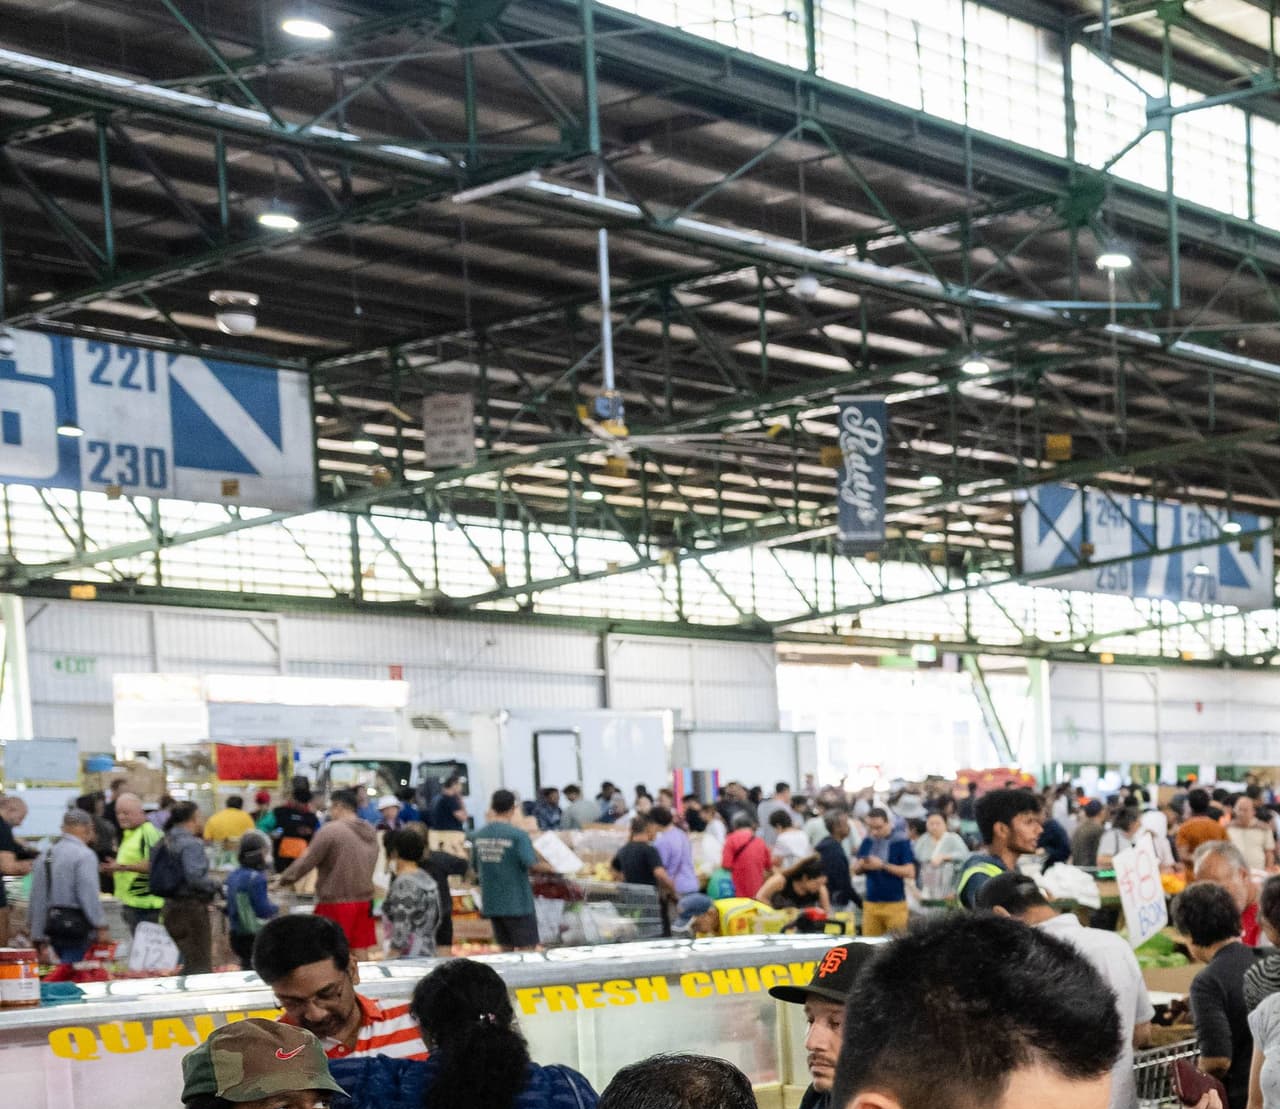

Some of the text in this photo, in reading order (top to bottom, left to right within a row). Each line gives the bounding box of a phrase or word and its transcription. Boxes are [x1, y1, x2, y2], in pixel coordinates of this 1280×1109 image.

[87, 341, 156, 393] 221
[87, 440, 167, 490] 230
[515, 976, 671, 1016] FRESH
